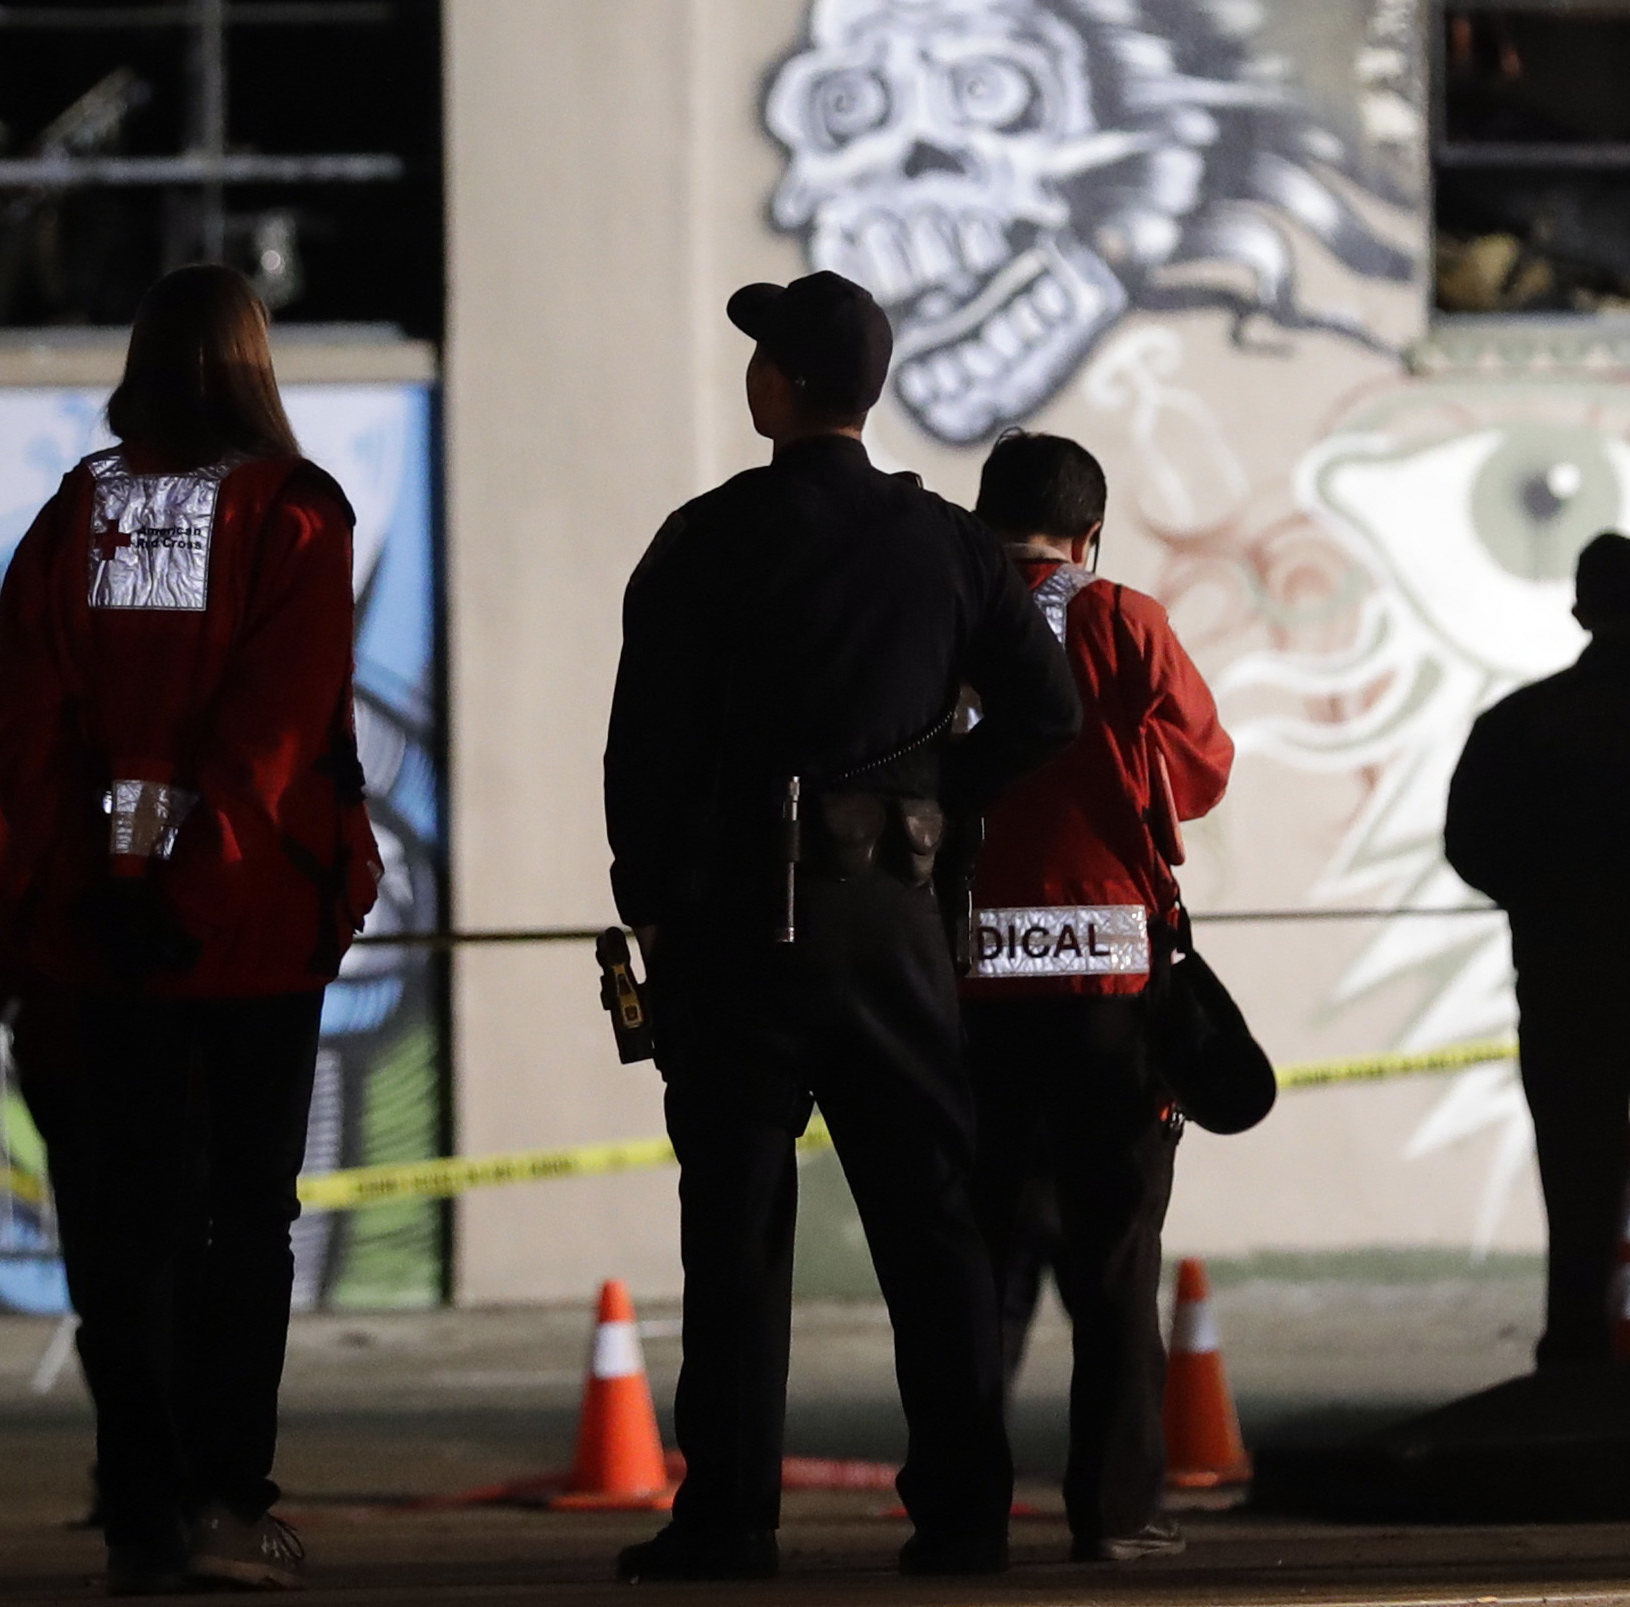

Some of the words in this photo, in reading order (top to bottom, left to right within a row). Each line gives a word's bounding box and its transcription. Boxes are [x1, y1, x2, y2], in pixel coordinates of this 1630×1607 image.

[136, 525, 201, 537] American
[162, 537, 202, 550] Cross
[977, 924, 1112, 960] DICAL
